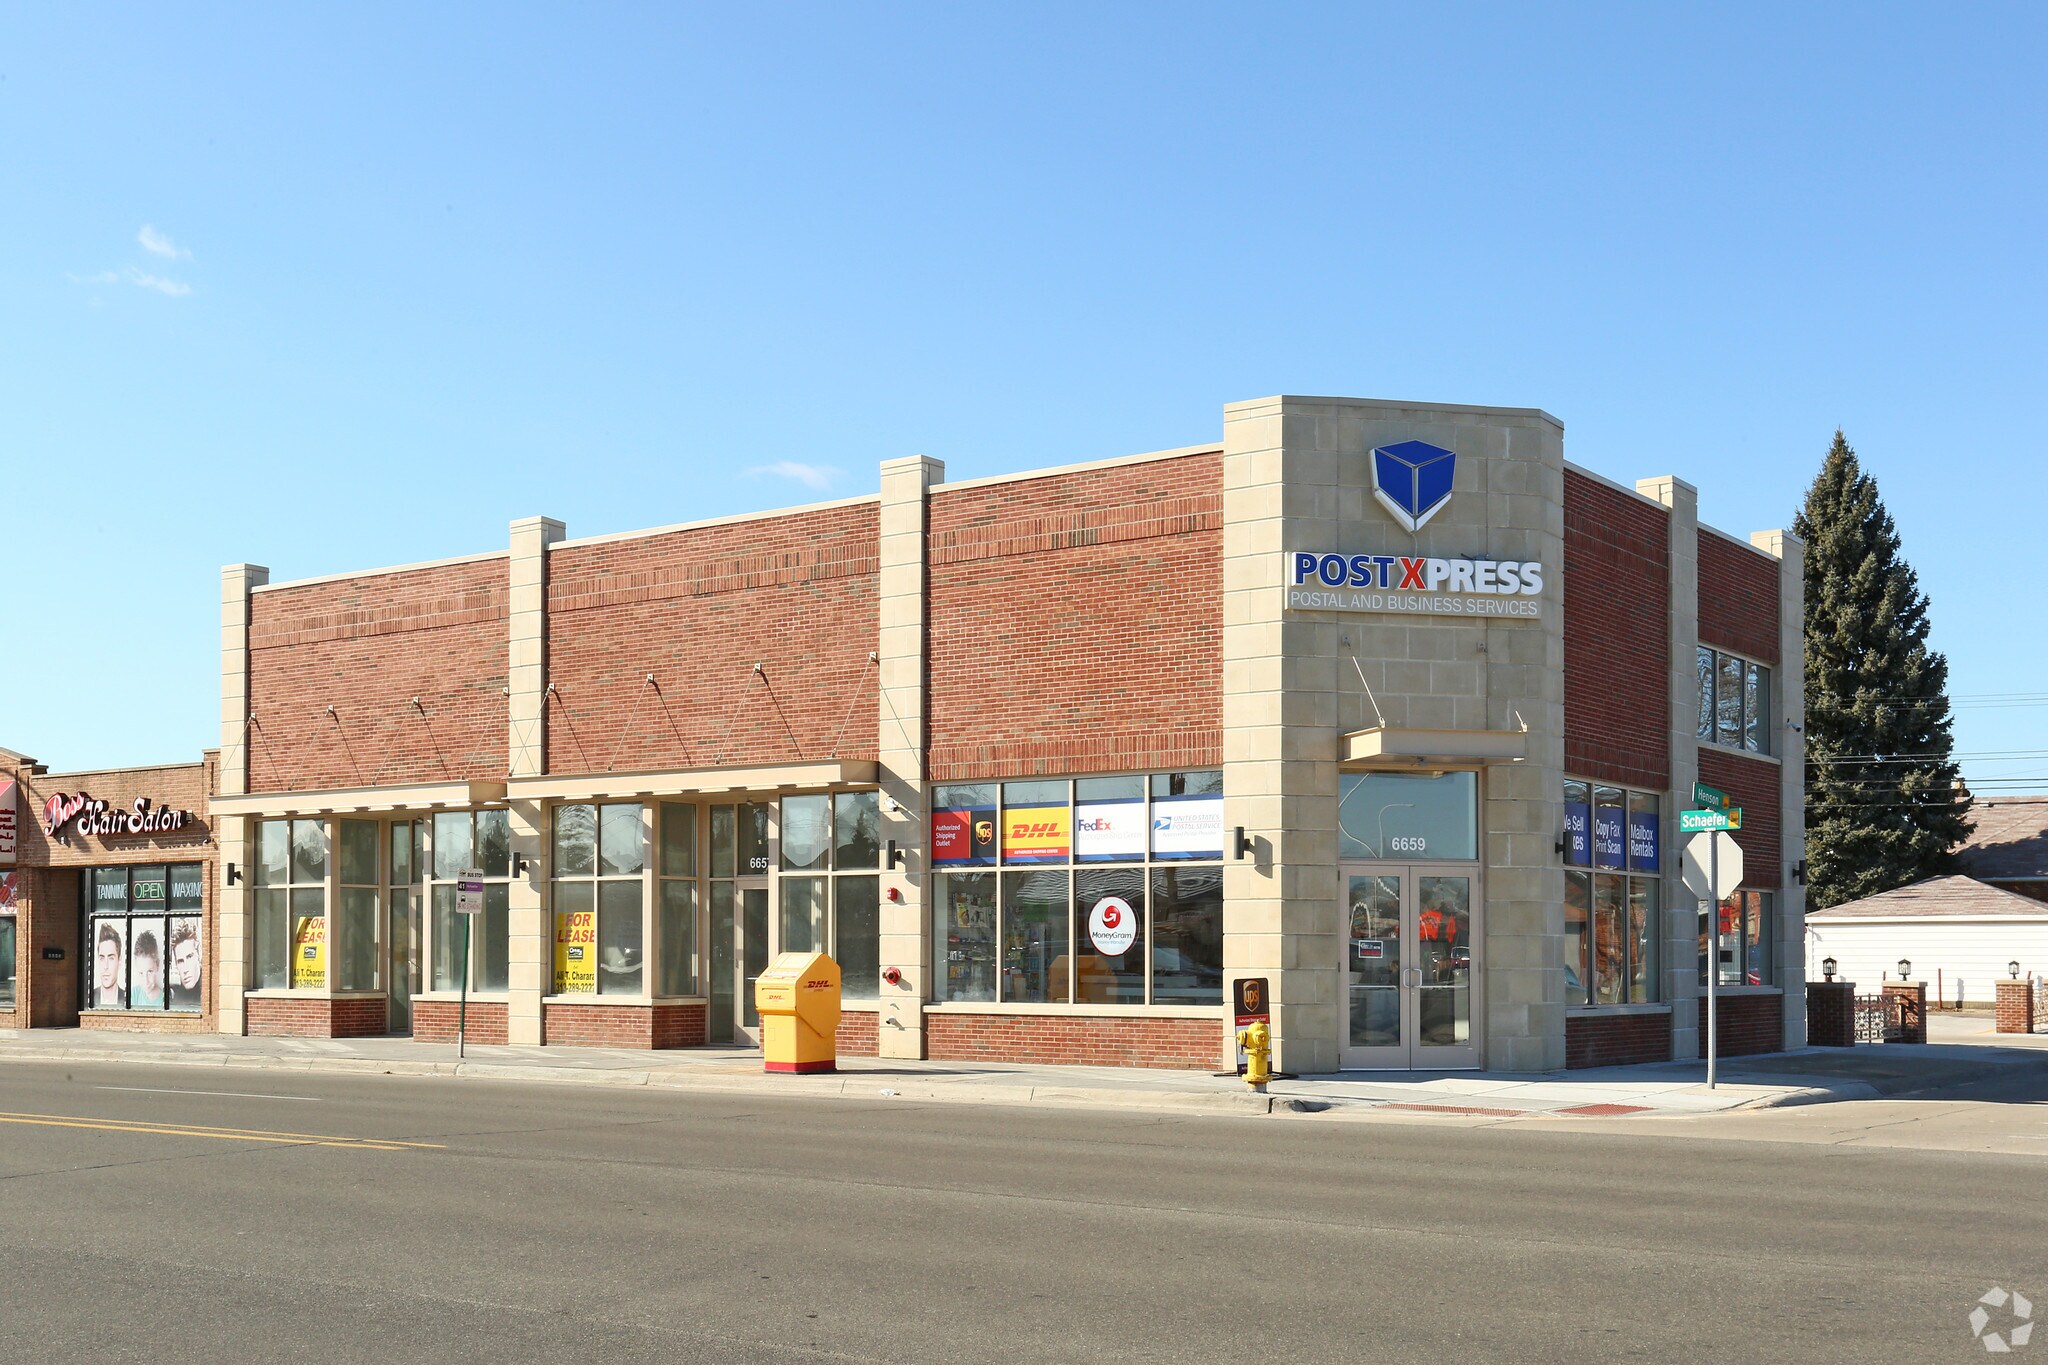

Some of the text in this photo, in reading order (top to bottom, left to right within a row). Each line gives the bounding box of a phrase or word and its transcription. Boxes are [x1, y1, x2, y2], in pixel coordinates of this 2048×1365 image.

[1291, 592, 1537, 616] POSTAL AND BUSINESS SERVICES
[1698, 788, 1719, 806] Henson
[43, 792, 85, 836] Boss
[77, 796, 182, 836] Hair Salon
[1682, 813, 1727, 828] Schaefer
[1011, 823, 1061, 839] DHL
[1078, 818, 1111, 832] FedEx
[1196, 821, 1221, 829] SERVICE
[1572, 815, 1584, 832] Sell
[1596, 818, 1620, 839] Copy Fax
[1631, 823, 1653, 841] Mailbox
[1391, 838, 1426, 851] 6659
[1596, 840, 1621, 855] Print Scan
[1631, 840, 1653, 858] Rentals
[133, 883, 165, 899] OPEN
[304, 917, 325, 930] FOR
[566, 913, 591, 927] FOR
[557, 929, 594, 943] LEASE
[1092, 931, 1132, 940] MoneyGram
[806, 980, 830, 988] DHL
[1245, 990, 1258, 1007] ups
